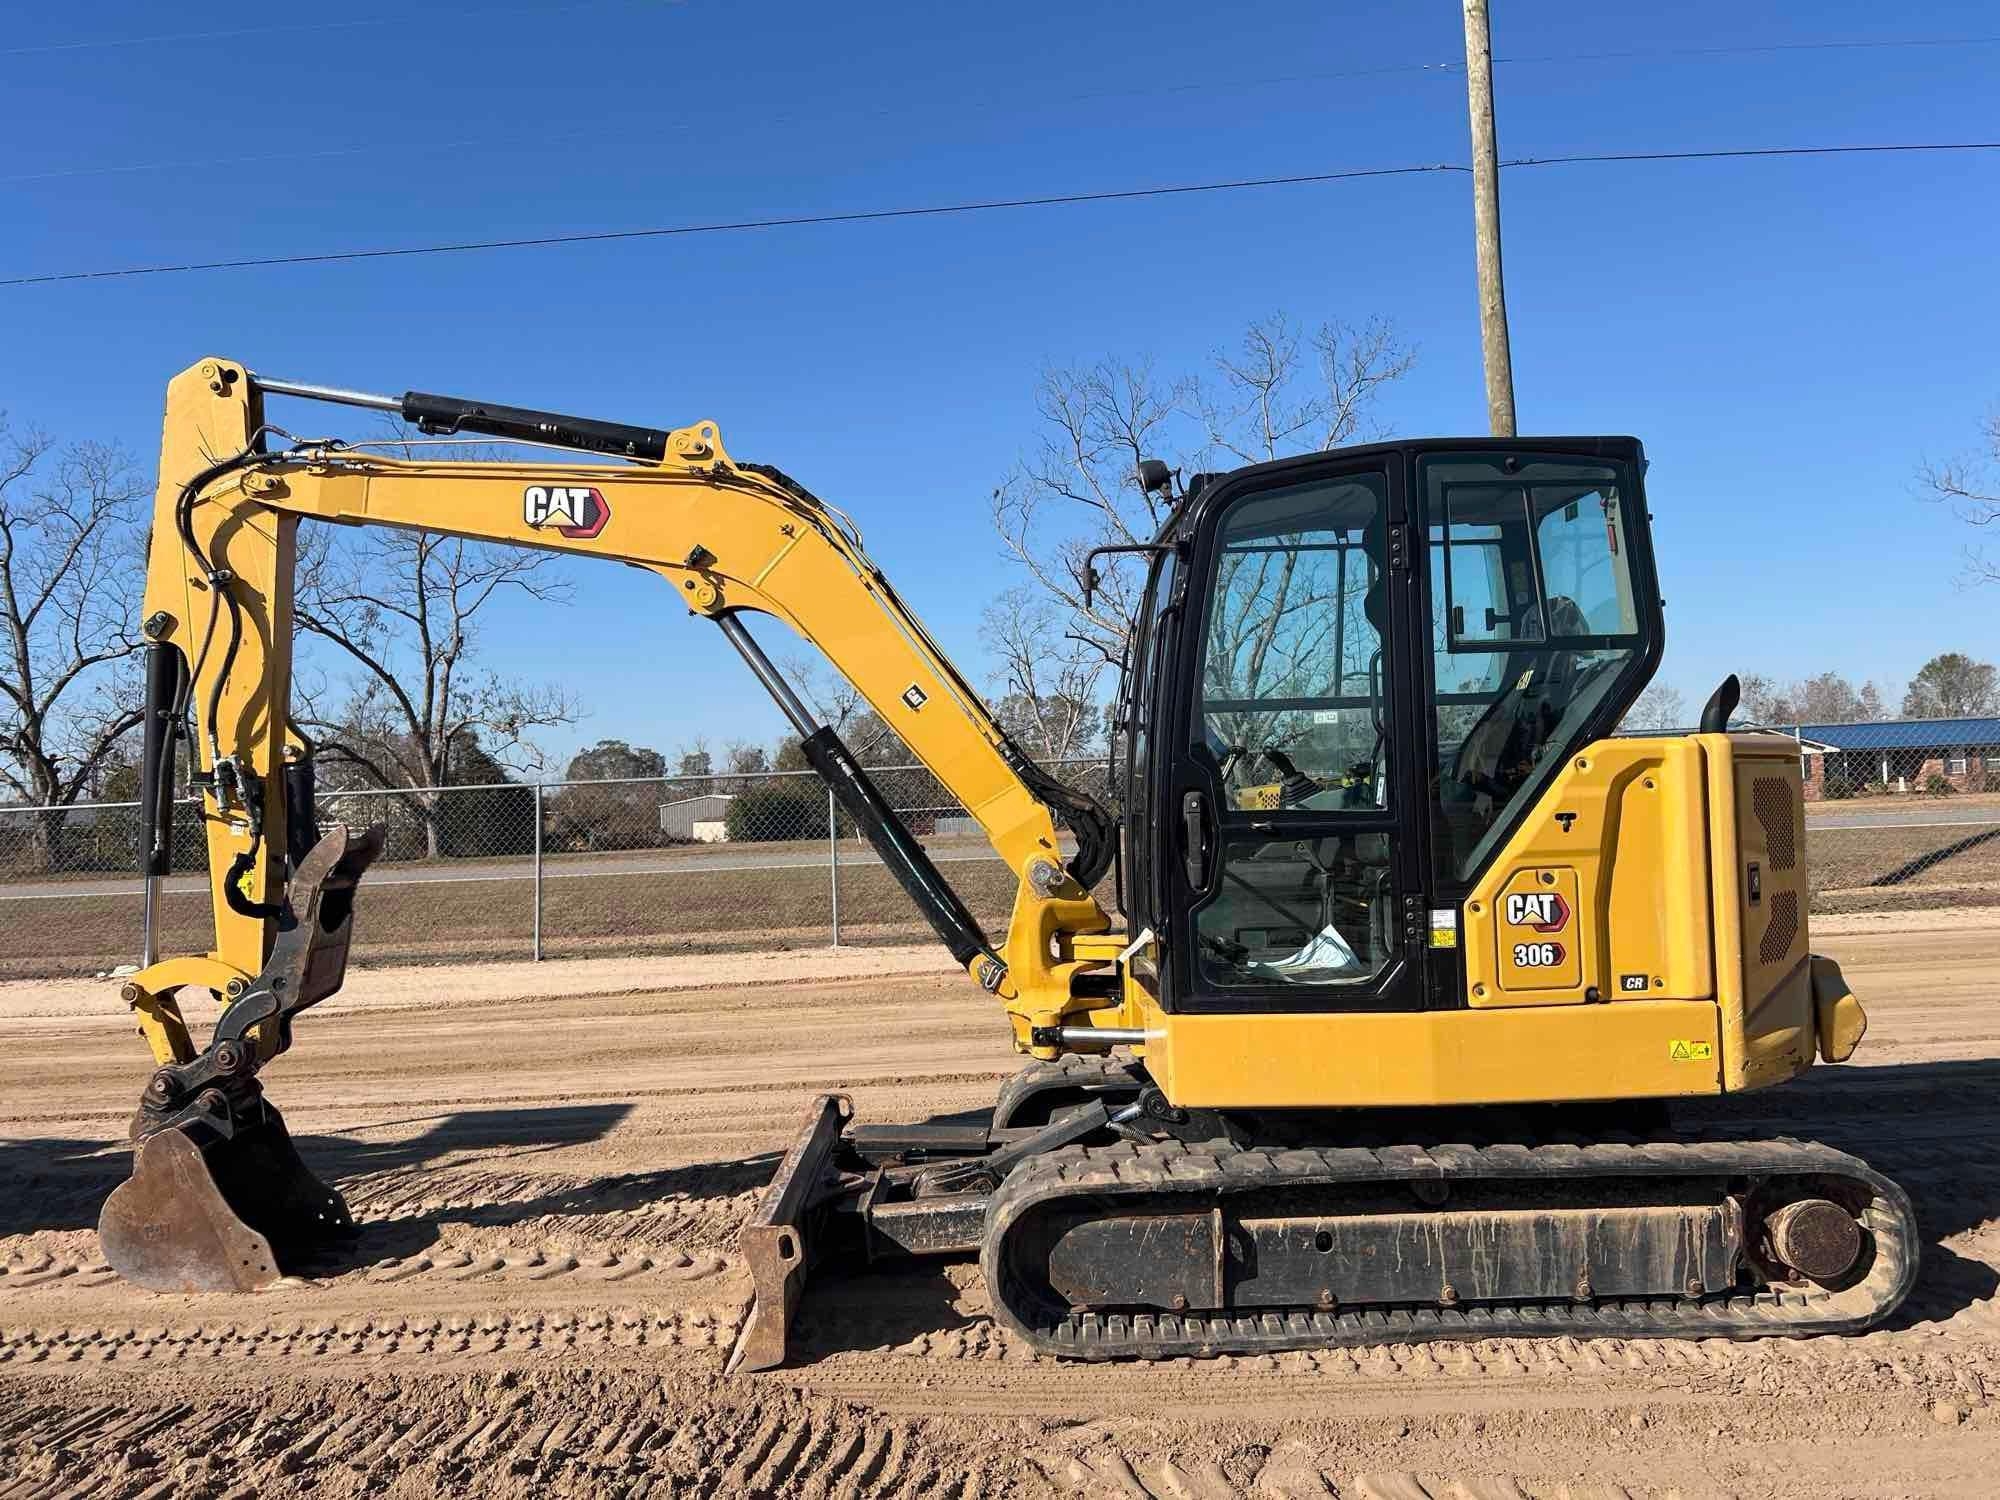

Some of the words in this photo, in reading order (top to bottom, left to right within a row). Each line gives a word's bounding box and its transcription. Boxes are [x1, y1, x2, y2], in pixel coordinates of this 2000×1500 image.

[525, 487, 590, 527] CAT
[1507, 894, 1555, 924] CAT
[1514, 944, 1554, 967] 306
[1626, 977, 1644, 989] CR
